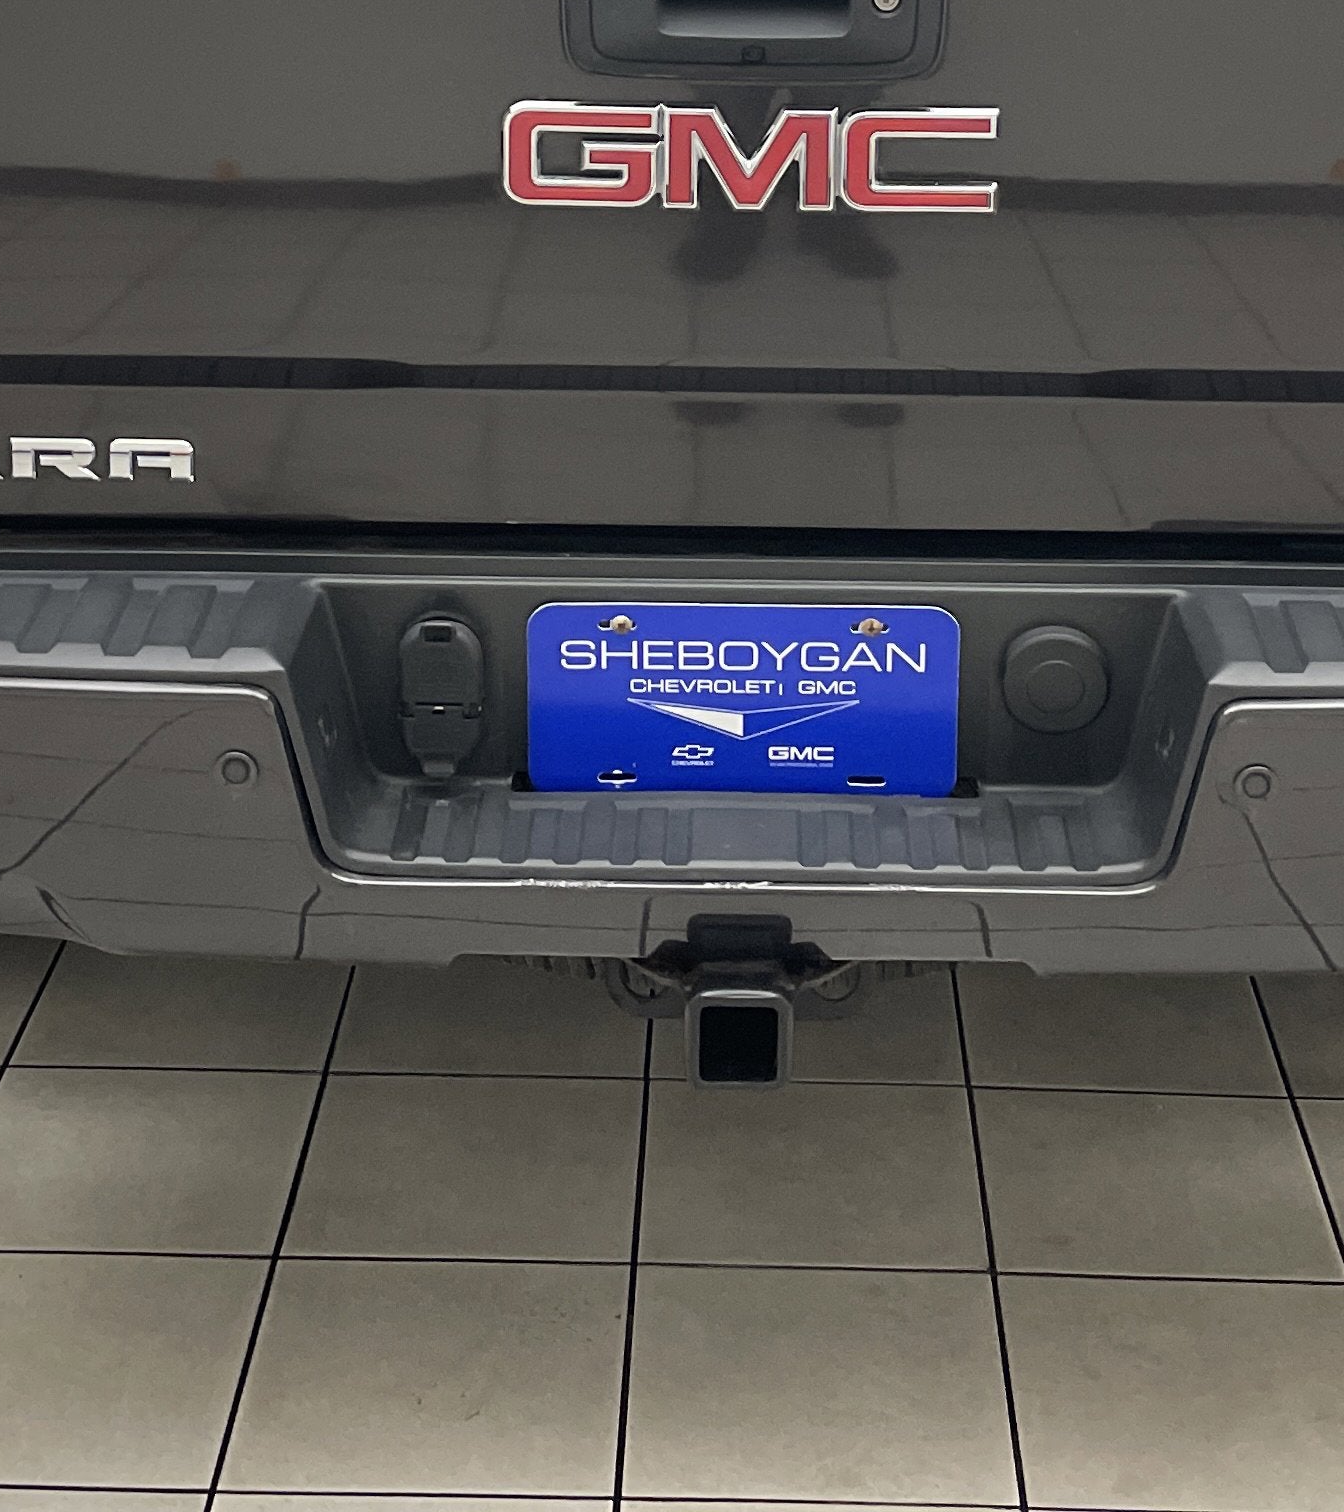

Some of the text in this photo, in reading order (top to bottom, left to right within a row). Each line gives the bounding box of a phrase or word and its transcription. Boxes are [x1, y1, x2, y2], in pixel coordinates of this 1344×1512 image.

[502, 99, 1001, 213] GMC
[560, 639, 926, 673] SHEBOYGAN
[629, 678, 856, 695] CHEVROLET GMC
[767, 746, 835, 761] GMC
